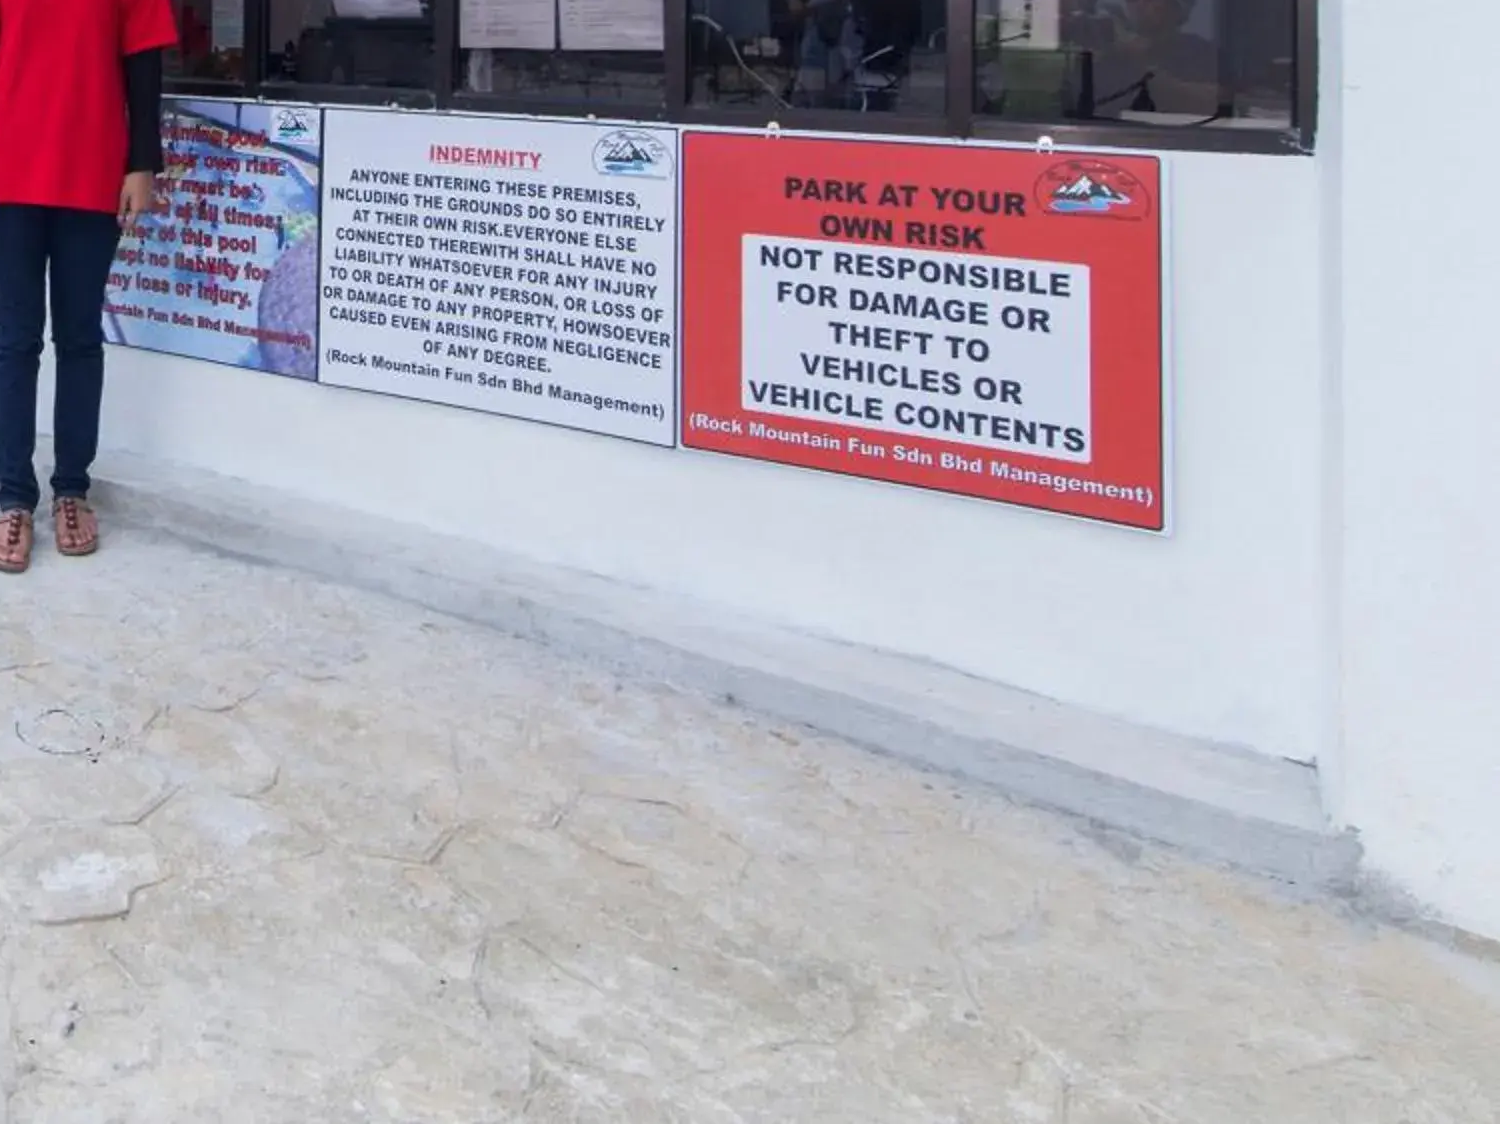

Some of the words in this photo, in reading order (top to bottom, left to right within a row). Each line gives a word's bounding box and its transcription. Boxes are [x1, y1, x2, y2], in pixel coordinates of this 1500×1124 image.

[204, 155, 240, 176] own
[430, 144, 542, 168] INDEMNITY
[181, 179, 224, 197] must
[350, 169, 409, 186] ANYONE
[414, 173, 491, 193] ENTERING
[496, 181, 547, 199] THESE
[552, 185, 641, 210] PREMISES,
[784, 176, 867, 204] PARK
[879, 183, 919, 208] AT
[930, 187, 1026, 217] YOUR
[331, 188, 409, 206] INCLUDING
[414, 194, 442, 209] THE
[448, 197, 523, 218] GROUNDS
[528, 205, 550, 220] DO
[556, 208, 577, 223] SO
[583, 211, 665, 233] ENTIRELY
[353, 209, 370, 222] AT
[375, 211, 418, 227] THEIR
[423, 215, 457, 232] OWN
[595, 234, 636, 252] ELSE
[180, 228, 213, 247] this
[218, 233, 258, 255] pool
[336, 227, 424, 249] CONNECTED
[429, 237, 519, 260] THEREWITH
[524, 247, 576, 267] SHALL
[581, 254, 625, 273] HAVE
[632, 260, 656, 277] NO
[819, 215, 893, 242] OWN
[905, 222, 986, 251] RISK
[136, 272, 170, 294] loss
[175, 281, 193, 298] or
[149, 252, 170, 267] no
[175, 251, 240, 282] liability
[335, 247, 404, 266] LIABILITY
[409, 255, 512, 280] WHATSOEVER
[518, 268, 549, 285] FOR
[554, 273, 589, 290] ANY
[594, 278, 657, 299] INJURY
[760, 245, 823, 271] NOT
[834, 251, 1071, 297] RESPONSIBLE
[330, 266, 347, 280] TO
[352, 269, 372, 283] OR
[377, 272, 424, 290] DEATH
[429, 278, 448, 293] OF
[453, 282, 485, 298] ANY
[490, 286, 558, 310] PERSON,
[564, 296, 586, 312] OR
[592, 300, 635, 319] LOSS
[641, 307, 663, 323] OF
[777, 281, 837, 308] FOR
[850, 289, 988, 326] DAMAGE
[1001, 306, 1051, 334] OR
[147, 307, 170, 323] Fun
[197, 315, 222, 332] Bhd
[323, 286, 342, 300] OR
[347, 288, 407, 309] DAMAGE
[412, 296, 431, 311] TO
[436, 300, 467, 316] ANY
[472, 305, 558, 334] PROPERTY,
[563, 319, 671, 347] HOWSOEVER
[329, 306, 387, 326] CAUSED
[391, 314, 430, 332] EVEN
[435, 321, 498, 343] ARISING
[503, 331, 547, 350] FROM
[553, 338, 661, 369] NEGLIGENCE
[423, 339, 442, 354] OF
[447, 344, 479, 360] ANY
[484, 349, 551, 373] DEGREE.
[828, 321, 933, 355] THEFT
[944, 335, 990, 362] TO
[326, 349, 367, 367] (Rock
[371, 355, 440, 378] Mountain
[445, 367, 473, 384] Fun
[478, 372, 507, 389] Sdn
[512, 378, 543, 395] Bhd
[548, 384, 664, 421] Management)
[800, 352, 961, 396] VEHICLES
[974, 377, 1022, 405] OR
[749, 380, 883, 421] VEHICLE
[892, 402, 1085, 454] CONTENTS
[689, 412, 743, 434] (Rock
[749, 422, 840, 450] Mountain
[848, 438, 885, 458] Fun
[893, 445, 932, 465] Sdn
[940, 452, 982, 473] Bhd
[991, 461, 1153, 508] Management)
